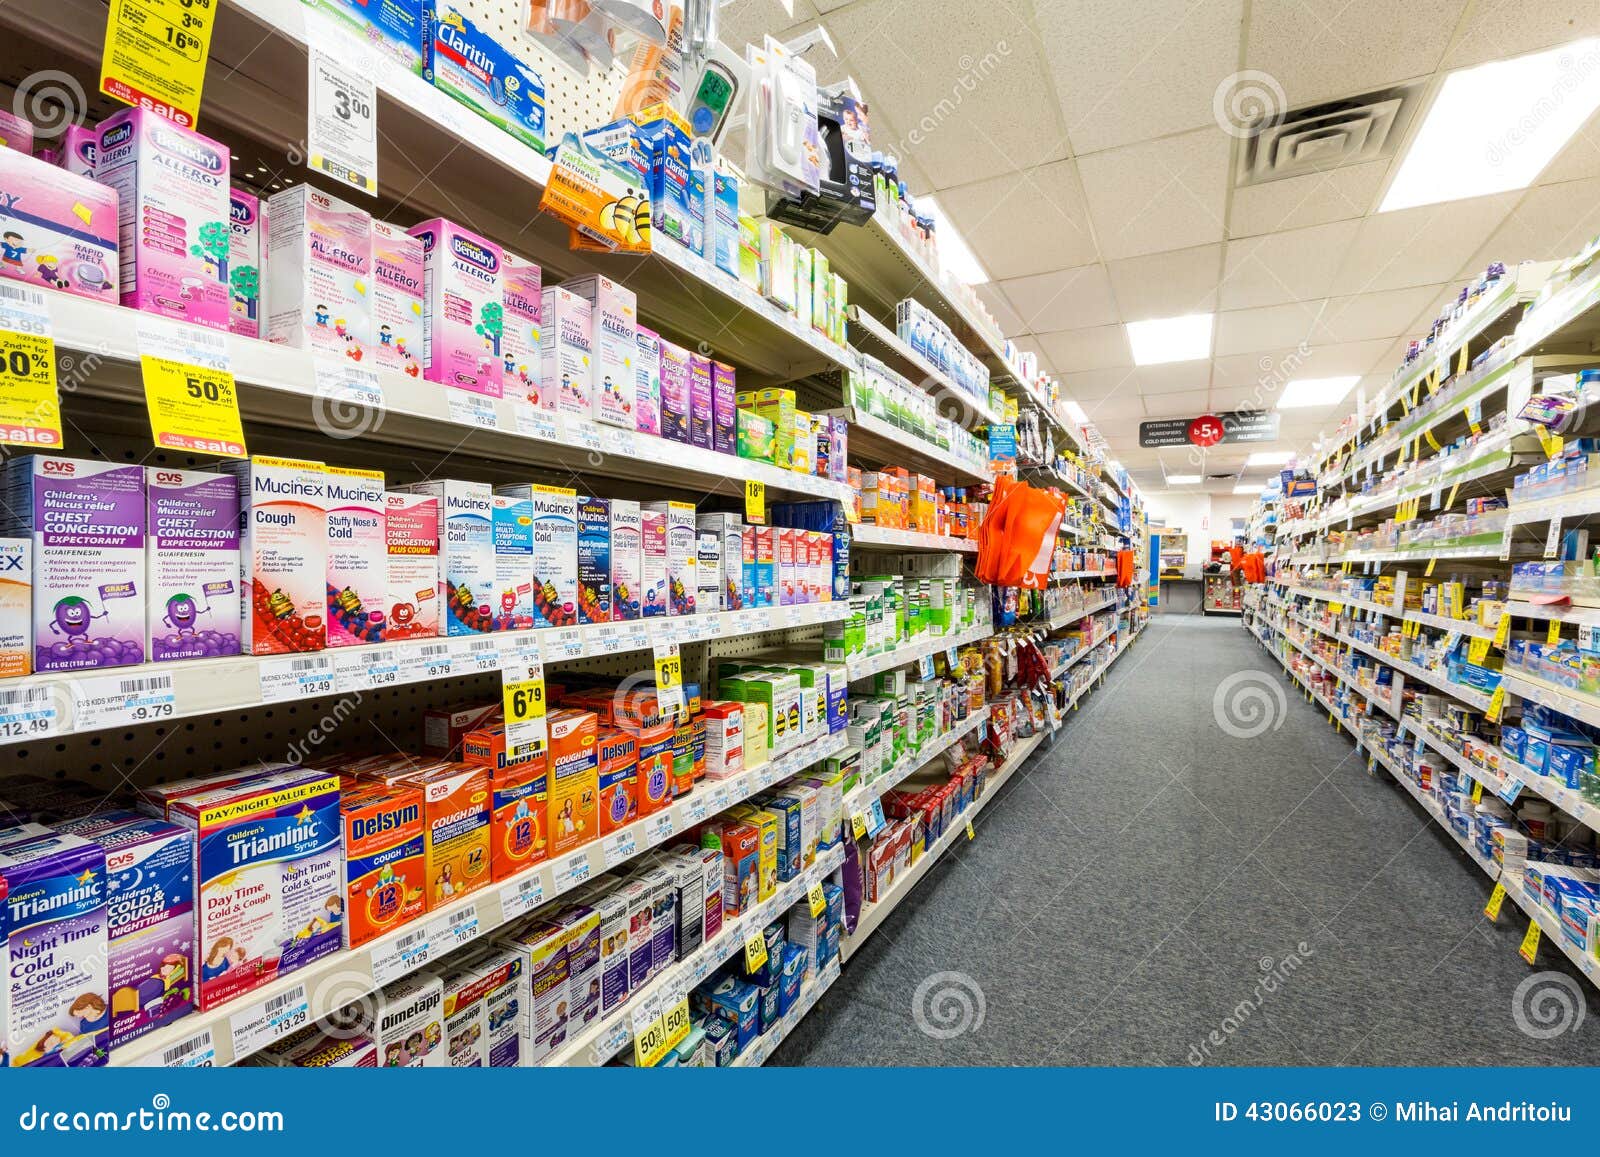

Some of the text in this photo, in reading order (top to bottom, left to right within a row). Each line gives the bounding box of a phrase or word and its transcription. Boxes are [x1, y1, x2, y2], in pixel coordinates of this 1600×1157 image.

[438, 24, 496, 75] Claritin
[140, 97, 189, 126] sale
[101, 145, 132, 165] ALLERGY
[153, 153, 220, 186] ALLERGY
[555, 174, 586, 194] RELIEF
[311, 193, 330, 207] CVS
[375, 223, 392, 235] CVS
[74, 244, 104, 259] RAPID
[76, 252, 102, 265] MELT
[454, 240, 497, 270] Benadryl
[376, 266, 419, 289] ALLERGY
[452, 260, 497, 285] ALLERGY
[602, 318, 634, 338] ALLERGY
[561, 330, 590, 348] ALLERGY
[35, 346, 48, 354] for
[33, 372, 48, 380] off
[194, 440, 240, 454] sale
[43, 460, 75, 472] CVS
[281, 462, 322, 470] FORMULA
[156, 472, 183, 483] CVS
[255, 477, 324, 497] Mucinex
[327, 485, 383, 503] Mucinex
[44, 490, 98, 501] Children's
[157, 498, 202, 508] Children's
[387, 497, 404, 505] CVS
[447, 496, 490, 511] Mucinex
[44, 500, 116, 511] Mucus relief
[157, 507, 216, 518] Mucus relief
[534, 502, 574, 515] Mucinex
[44, 512, 92, 523] CHEST
[157, 518, 197, 528] CHEST
[256, 510, 296, 526] Cough
[328, 516, 378, 527] Stuffy Nose &
[670, 513, 695, 526] Mucinex
[44, 523, 138, 536] CONGESTION
[157, 529, 235, 539] CONGESTION
[328, 527, 353, 539] Cold
[387, 530, 412, 538] CHEST
[448, 531, 466, 542] Cold
[534, 532, 552, 542] Cold
[48, 536, 126, 545] EXPECTORANT
[160, 539, 225, 547] EXPECTORANT
[387, 538, 435, 547] CONGESTION
[70, 660, 84, 668] (118
[85, 658, 98, 666] mL)
[77, 700, 90, 708] CVS
[91, 698, 105, 707] KIDS
[555, 724, 568, 734] CVS
[602, 739, 635, 761] Delsym
[430, 785, 448, 796] CVS
[205, 781, 336, 822] DAY/NIGHT VALUE PACK
[352, 804, 418, 841] Delsym
[432, 804, 483, 829] COUGH DM
[227, 826, 265, 842] Children's
[227, 822, 319, 864] Triaminic
[294, 839, 318, 852] Syrup
[107, 852, 134, 868] CVS
[373, 849, 402, 865] COUGH
[281, 860, 332, 883] Night Time
[281, 869, 336, 894] Cold & Cough
[8, 881, 102, 922] Triaminic
[107, 883, 160, 906] Children's
[208, 882, 265, 910] Day Time
[378, 888, 396, 906] 12
[76, 898, 101, 910] Syrup
[108, 889, 165, 918] COLD &
[208, 893, 271, 922] Cold & Cough
[108, 901, 165, 929] COUGH
[601, 906, 627, 927] Dimetapp
[111, 910, 170, 938] NIGHTTIME
[10, 924, 100, 963] Night Time
[11, 953, 54, 978] Cold
[11, 982, 21, 993] &
[25, 962, 75, 987] Cough
[381, 993, 441, 1032] Dimetapp
[234, 1018, 265, 1036] TRIAMINIC
[274, 1012, 306, 1035] $13.29
